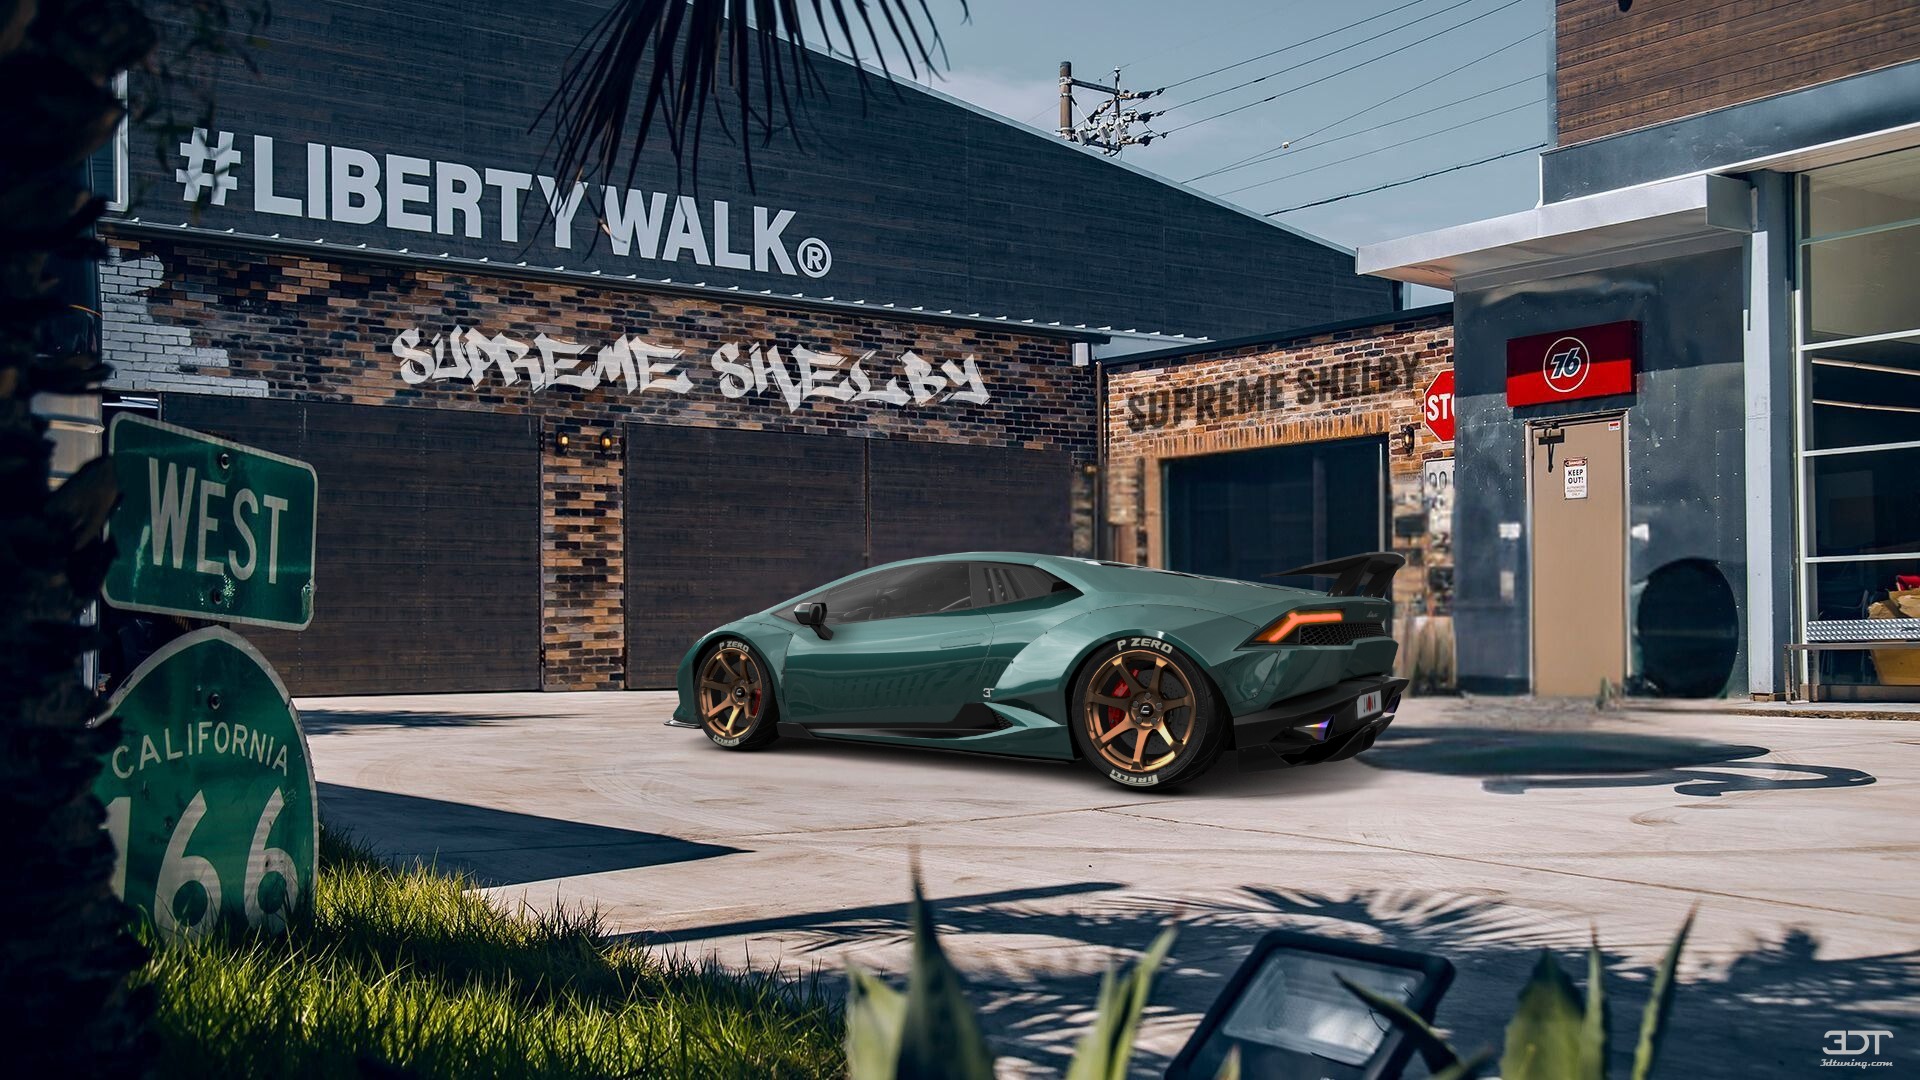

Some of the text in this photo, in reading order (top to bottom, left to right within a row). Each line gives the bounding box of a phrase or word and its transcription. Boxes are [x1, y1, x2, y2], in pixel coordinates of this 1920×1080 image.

[176, 126, 588, 249] #LIBERTY
[391, 324, 991, 413] SUPREME SHELBY
[1550, 346, 1581, 379] 76
[1127, 351, 1421, 433] SUPREME SHELBY
[1427, 393, 1455, 421] ST
[1567, 476, 1584, 484] OUT!
[149, 457, 289, 585] WEST
[726, 640, 749, 652] ZERO
[1116, 637, 1174, 655] P ZERO
[111, 721, 288, 777] CALIFORNIA
[1109, 769, 1159, 787] PIRELLI
[99, 786, 299, 946] 166
